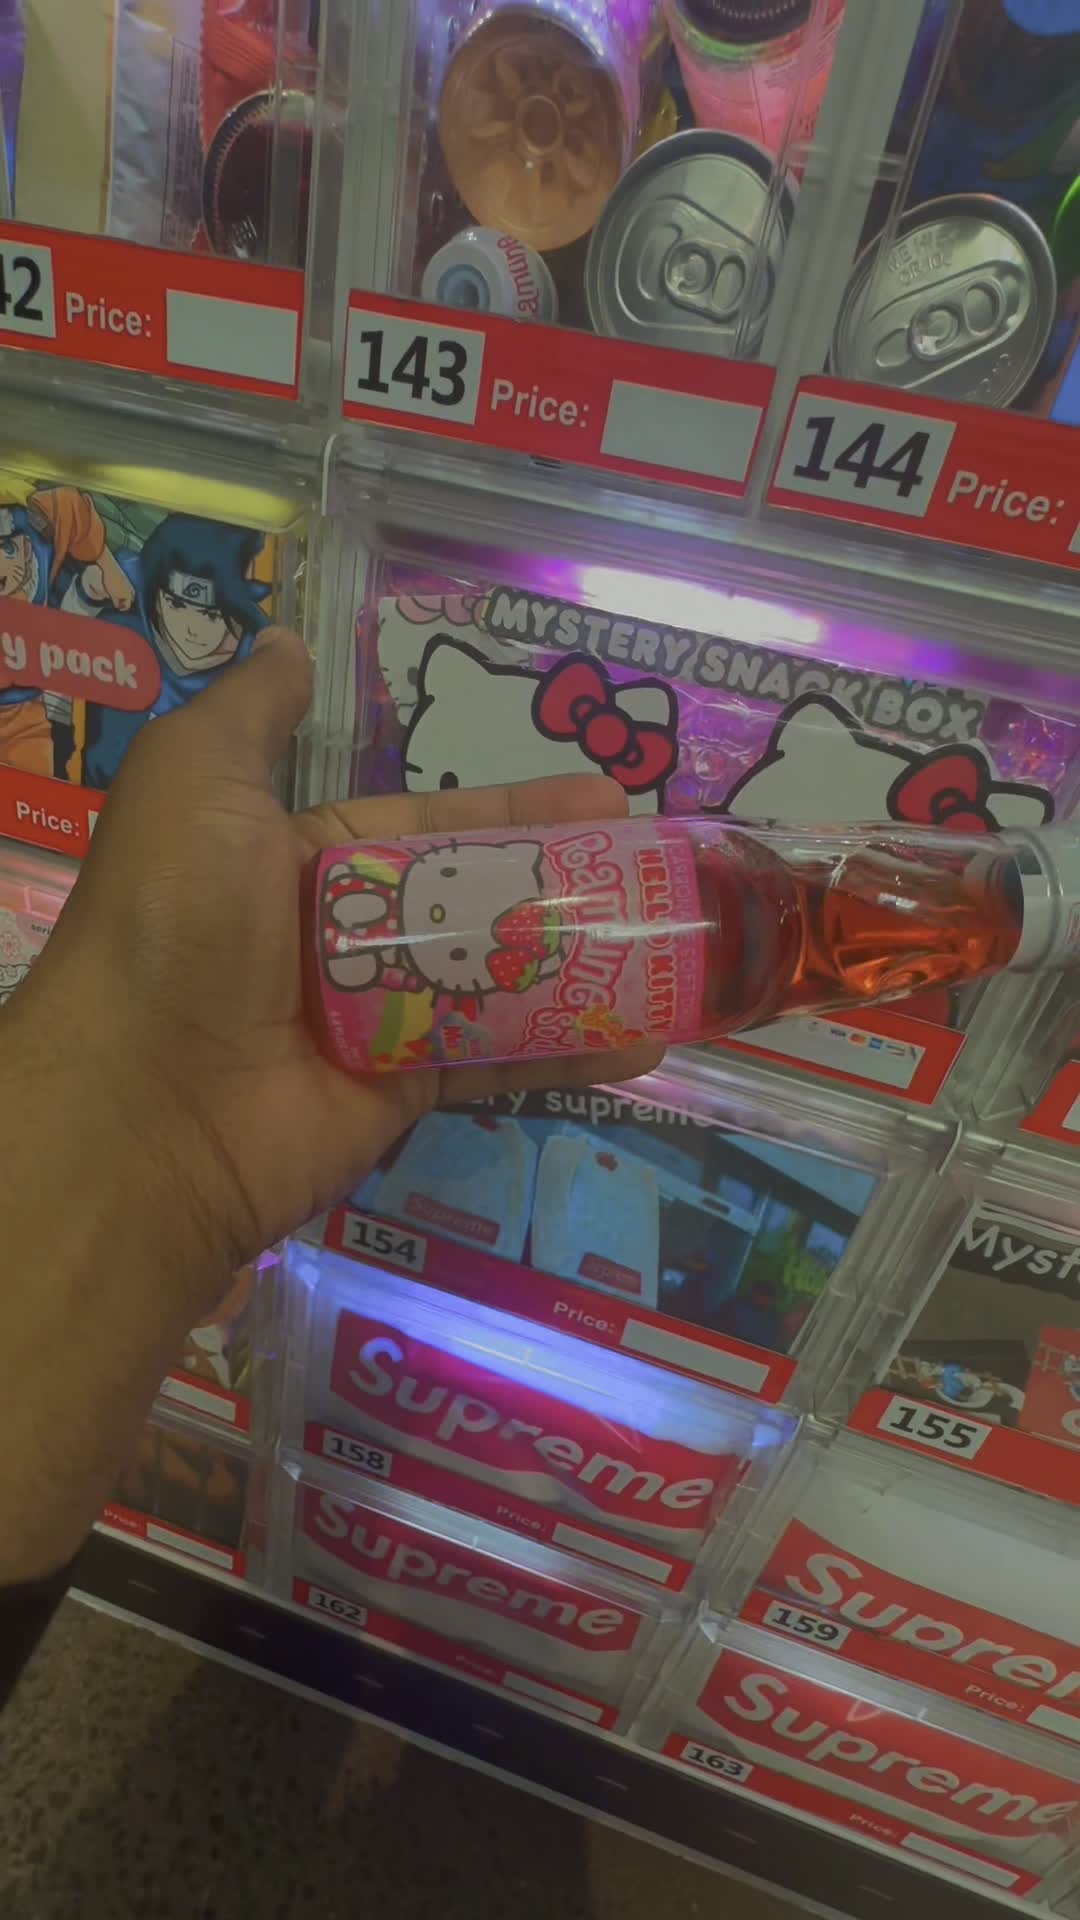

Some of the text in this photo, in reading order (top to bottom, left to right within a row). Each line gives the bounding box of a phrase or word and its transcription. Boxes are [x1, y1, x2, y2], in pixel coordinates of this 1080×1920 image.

[64, 291, 153, 338] Price:
[356, 330, 469, 408] 143
[489, 378, 590, 430] Price:
[793, 416, 930, 498] 144
[946, 470, 1065, 525] Price:
[39, 641, 138, 689] pack
[491, 593, 690, 675] MYSTERY
[870, 690, 980, 742] BOX
[15, 800, 81, 838] Price:
[648, 954, 678, 1033] KITTY
[350, 1221, 418, 1264] 154
[553, 1300, 616, 1335] Price:
[348, 1337, 716, 1510] Supreme
[888, 1405, 979, 1449] 155
[329, 1436, 385, 1470] 158
[313, 1490, 623, 1636] Supreme
[313, 1590, 363, 1620] 162
[770, 1607, 840, 1642] 159
[965, 1683, 1024, 1714] Price:
[688, 1748, 744, 1777] 163
[724, 1673, 1078, 1824] Supreme
